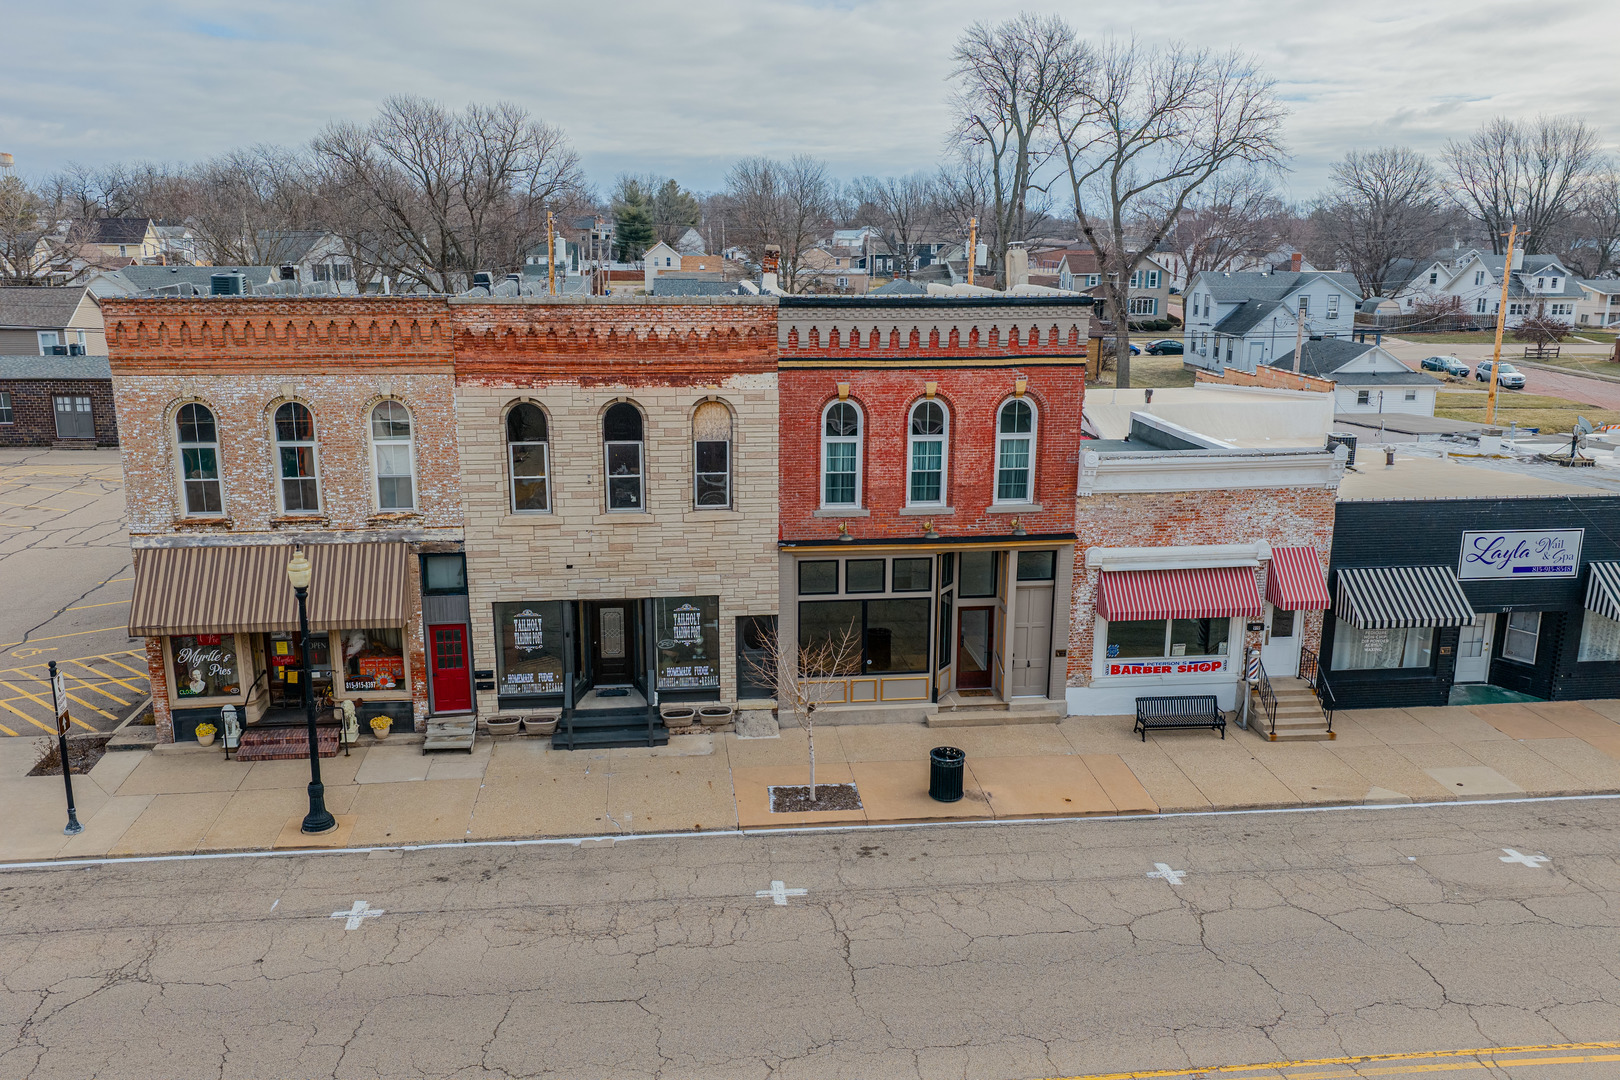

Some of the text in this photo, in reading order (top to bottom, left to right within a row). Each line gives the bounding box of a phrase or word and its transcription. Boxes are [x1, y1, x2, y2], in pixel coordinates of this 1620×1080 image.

[1535, 537, 1564, 553] Nail
[1466, 536, 1530, 570] Layla
[1542, 549, 1574, 563] & Spa
[208, 663, 232, 677] Pies
[1110, 661, 1222, 675] BARBER SHOP
